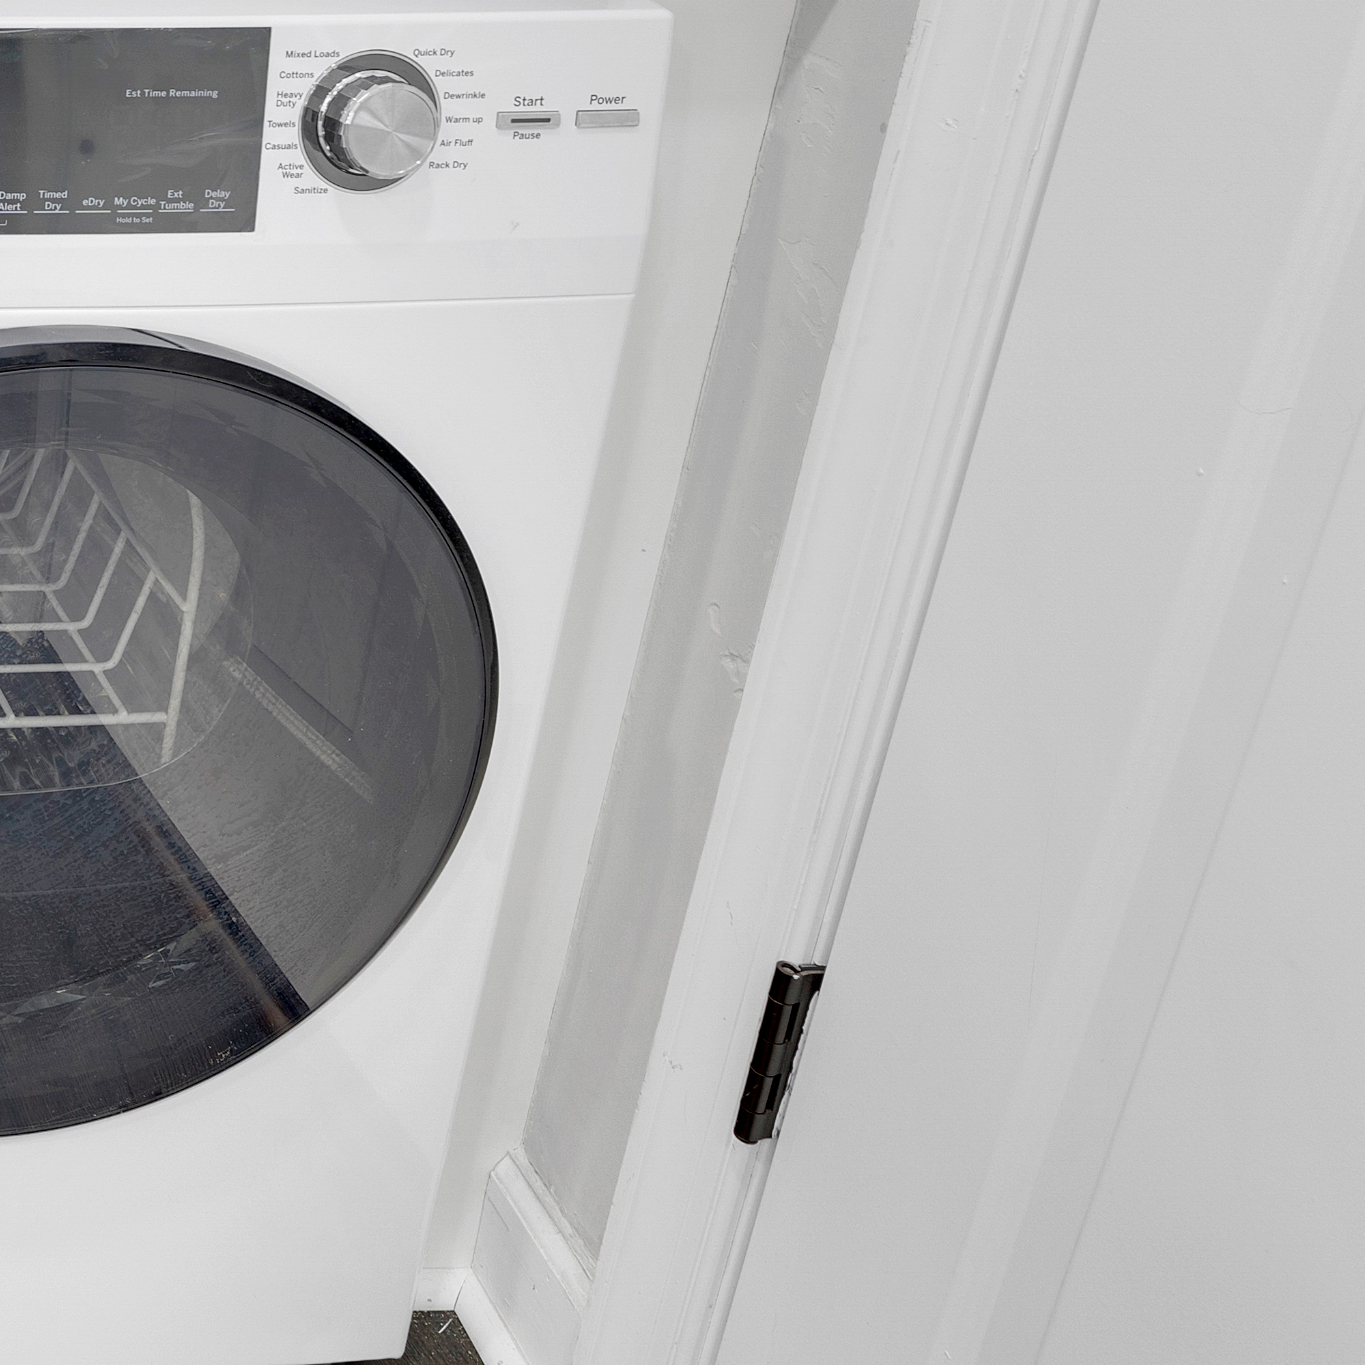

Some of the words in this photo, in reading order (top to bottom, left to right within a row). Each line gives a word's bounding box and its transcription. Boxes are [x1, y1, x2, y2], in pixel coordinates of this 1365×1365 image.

[314, 50, 340, 58] Loads
[413, 49, 437, 58] Quick
[440, 49, 455, 57] Dry
[280, 71, 314, 79] Cottons
[126, 89, 141, 97] Est
[144, 89, 167, 97] Time
[169, 89, 218, 98] Remaining
[277, 91, 303, 100] Heavy
[276, 100, 297, 108] Duty
[514, 96, 544, 107] Start
[590, 94, 626, 105] Power
[267, 120, 296, 128] Towels
[513, 131, 541, 140] Pause
[265, 142, 298, 150] Casuals
[454, 139, 473, 147] Fluff
[453, 161, 468, 170] Dry
[0, 191, 26, 201] Damp
[38, 190, 68, 198] Timed
[168, 190, 183, 198] Ext
[205, 189, 230, 199] Delay
[82, 198, 105, 207] eDry
[114, 197, 129, 206] My
[130, 197, 156, 206] Cycle
[209, 200, 225, 209] Dry
[45, 202, 62, 211] Dry
